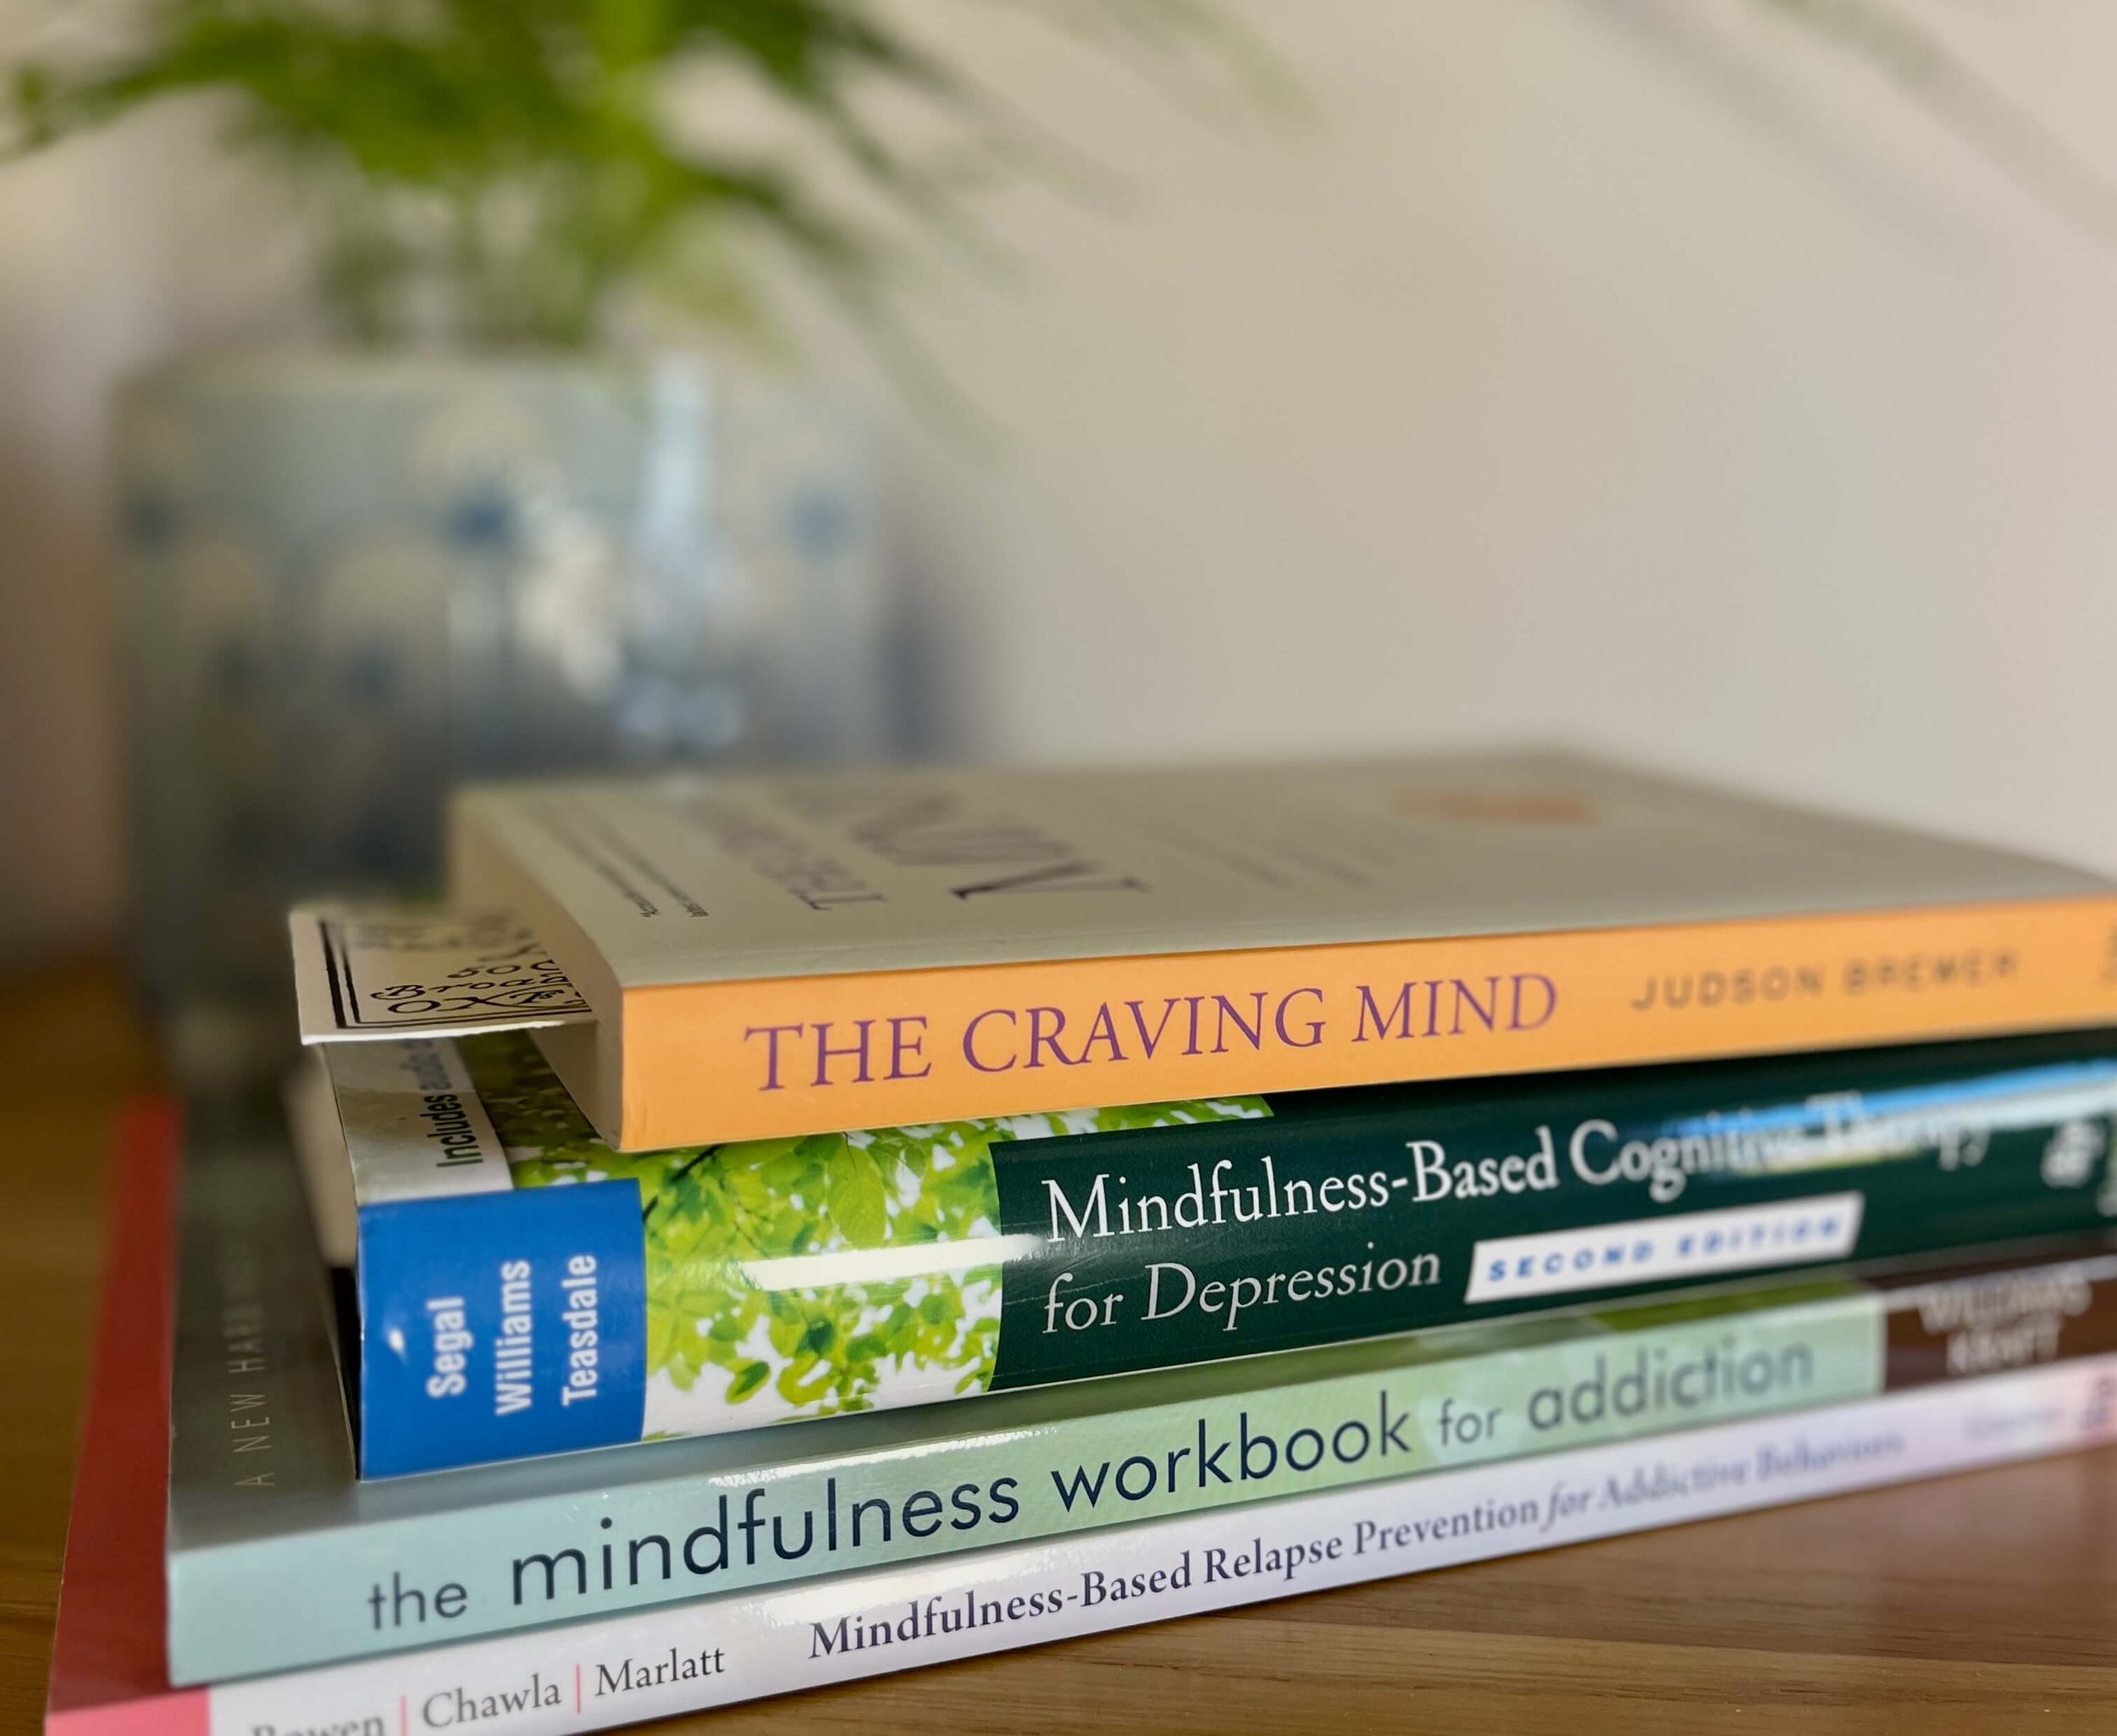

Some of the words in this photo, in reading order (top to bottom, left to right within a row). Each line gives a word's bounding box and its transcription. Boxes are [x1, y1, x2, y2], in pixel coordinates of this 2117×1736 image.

[744, 1016, 931, 1091] THE
[963, 987, 1326, 1073] CRAVING
[1351, 972, 1557, 1042] MIND
[1629, 964, 1823, 1011] JUDSON
[423, 1095, 484, 1167] Includes
[1041, 1125, 1559, 1243] Mindfulness-Based
[1042, 1273, 1124, 1334] for
[1141, 1241, 1440, 1332] Depression
[1488, 1241, 1655, 1283] SECOND
[426, 1296, 474, 1398] Segal
[495, 1259, 532, 1417] Williams
[561, 1254, 598, 1407] Teasdale
[229, 1393, 273, 1453] NEW
[234, 1471, 276, 1487] A
[368, 1572, 468, 1631] the
[512, 1478, 1020, 1606] mindfulness
[1050, 1390, 1412, 1512] workbook
[1438, 1398, 1503, 1446] for
[1527, 1335, 1816, 1431] addiction
[808, 1550, 1192, 1660] Mindfulness-Based
[1203, 1537, 1343, 1584] Relapse
[1353, 1497, 1539, 1556] Prevention
[1539, 1479, 1595, 1533] for
[423, 1673, 562, 1729] Chawla
[594, 1647, 726, 1697] Marlatt
